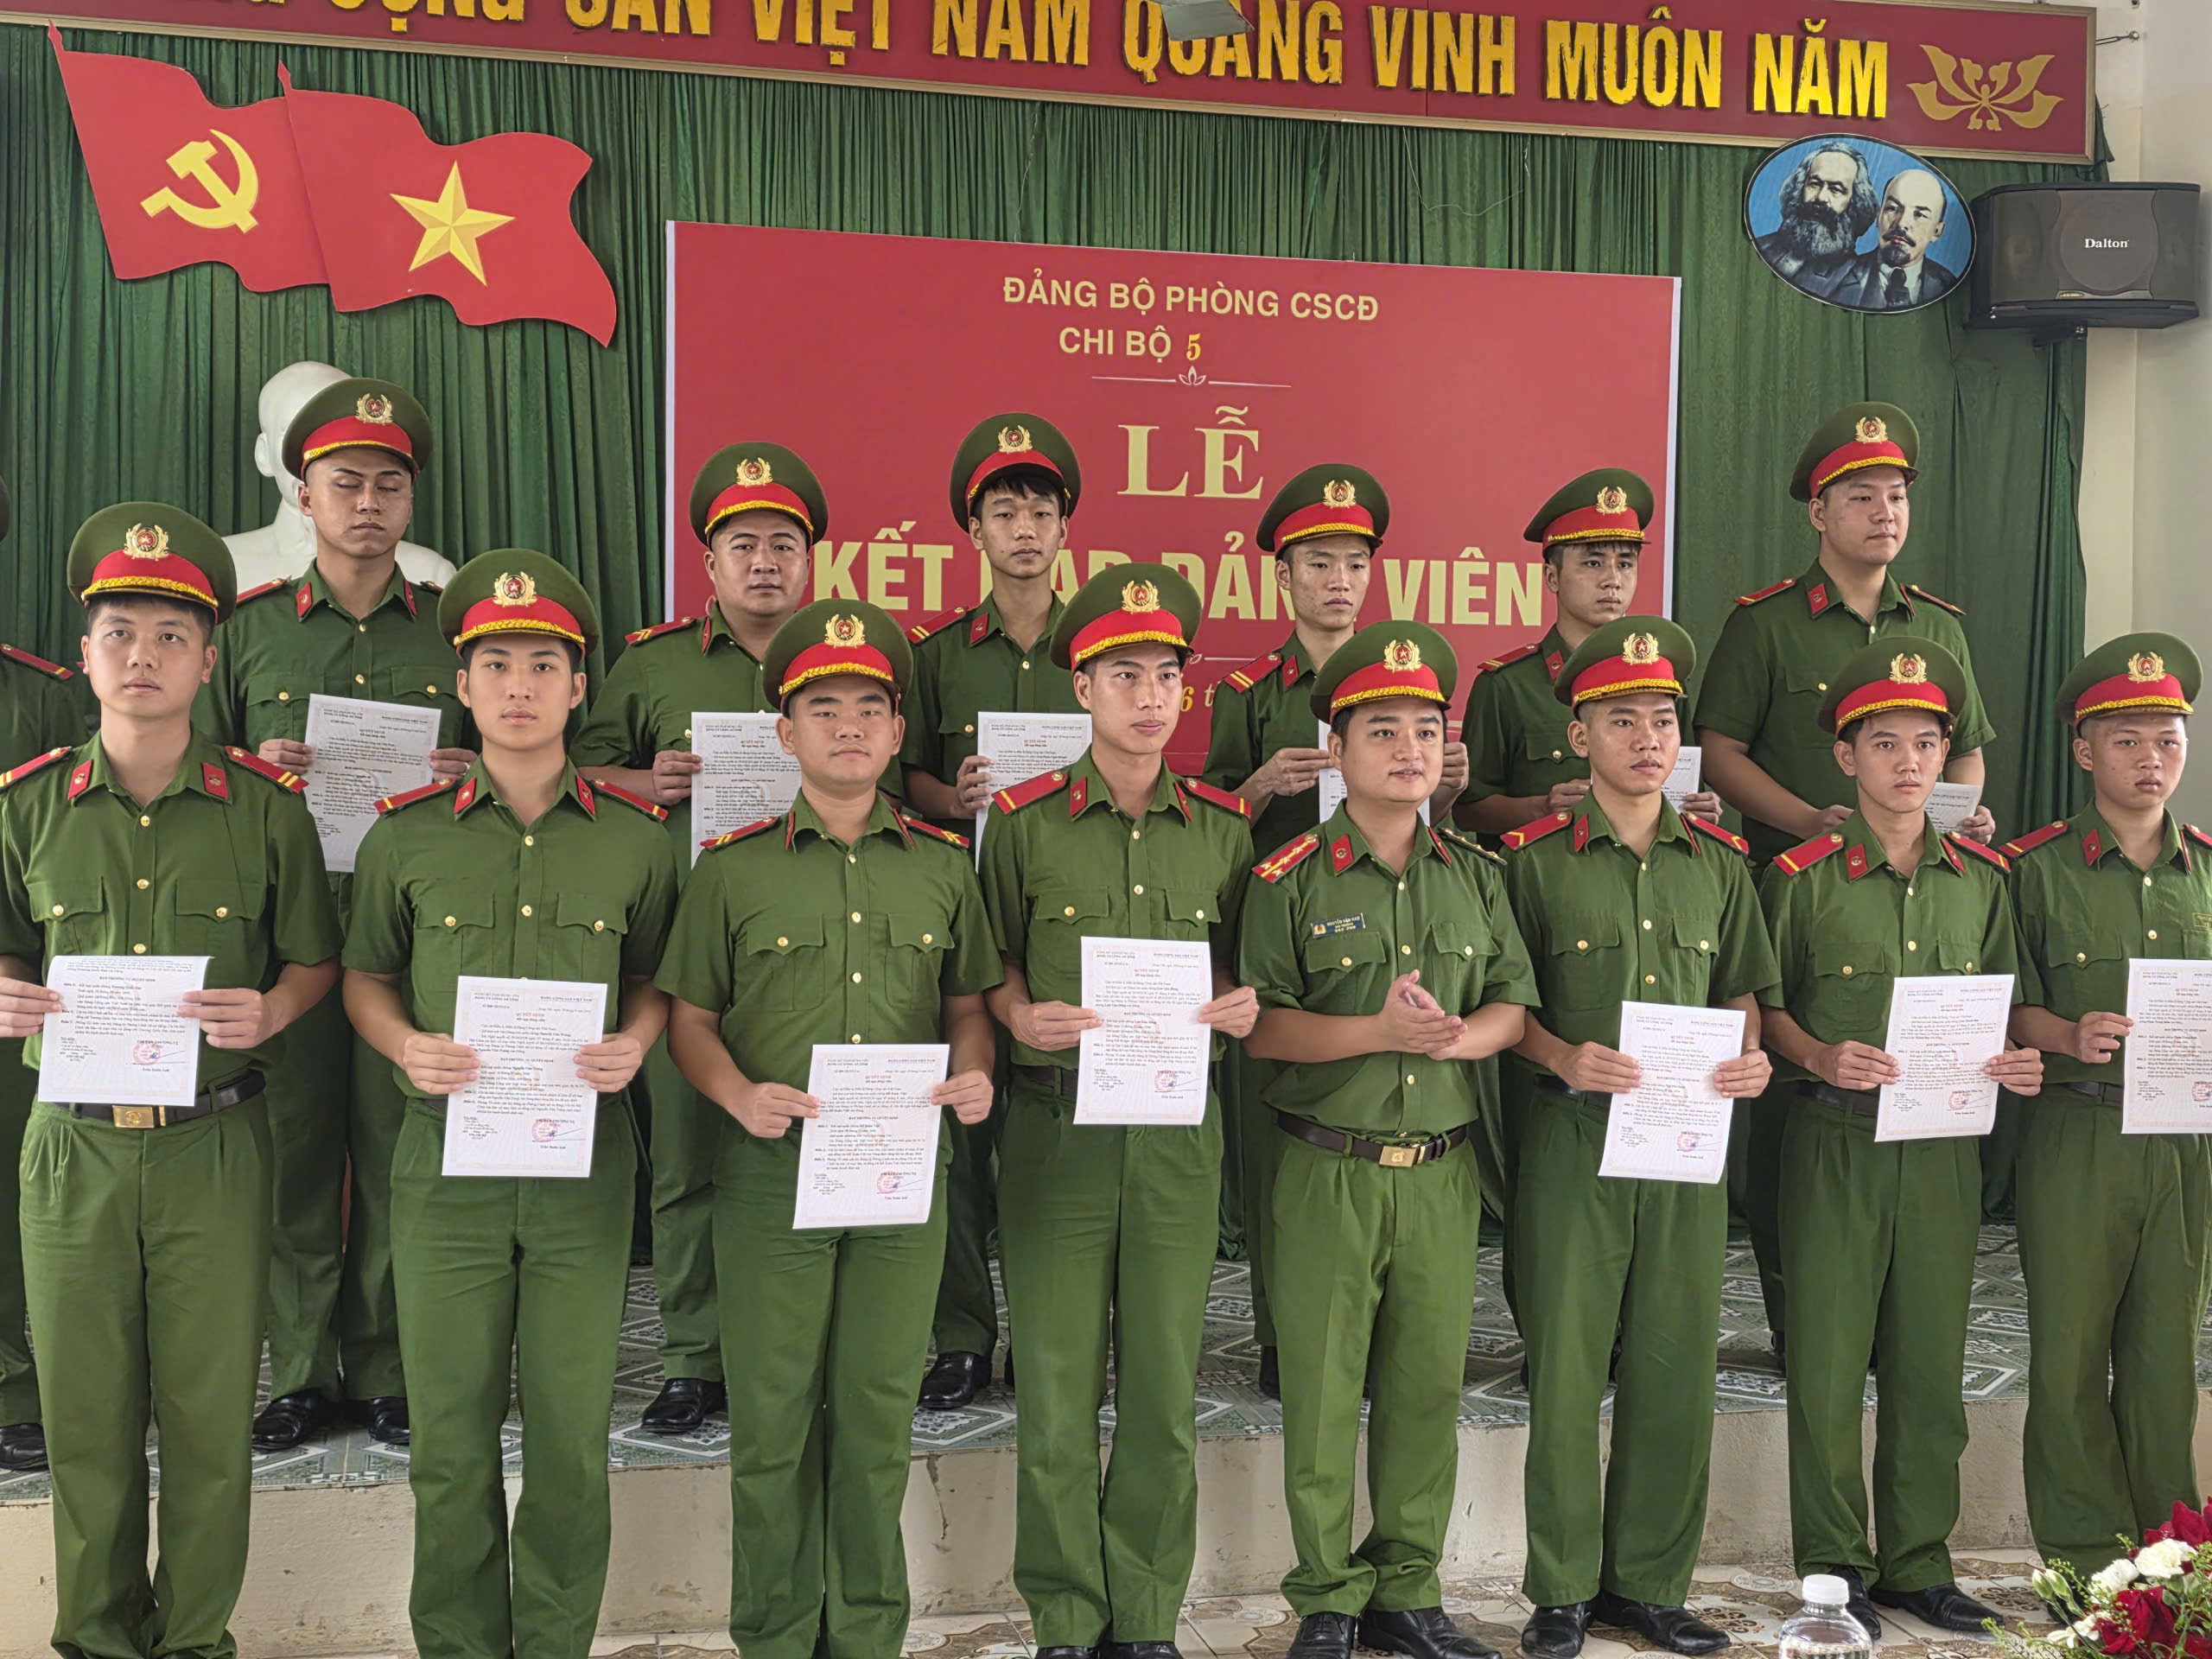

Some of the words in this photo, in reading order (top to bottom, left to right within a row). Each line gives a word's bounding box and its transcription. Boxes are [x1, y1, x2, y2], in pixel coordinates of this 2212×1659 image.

[931, 0, 1090, 67] NAM
[1369, 5, 1516, 96] VINH
[1545, 5, 1723, 109] MUÔN
[1752, 18, 1888, 118] NĂM
[2084, 238, 2128, 249] Dalton
[1003, 268, 1097, 307] ĐẢNG
[1109, 277, 1156, 315] BỘ
[1166, 281, 1280, 318] PHÒNG
[1290, 291, 1379, 321] CSCĐ
[1058, 327, 1114, 356] CHI
[1126, 325, 1173, 363] BỘ
[1185, 333, 1202, 361] 5
[1116, 405, 1263, 499] LỄ
[814, 521, 954, 611] KẾT
[1382, 546, 1543, 626] VIÊN
